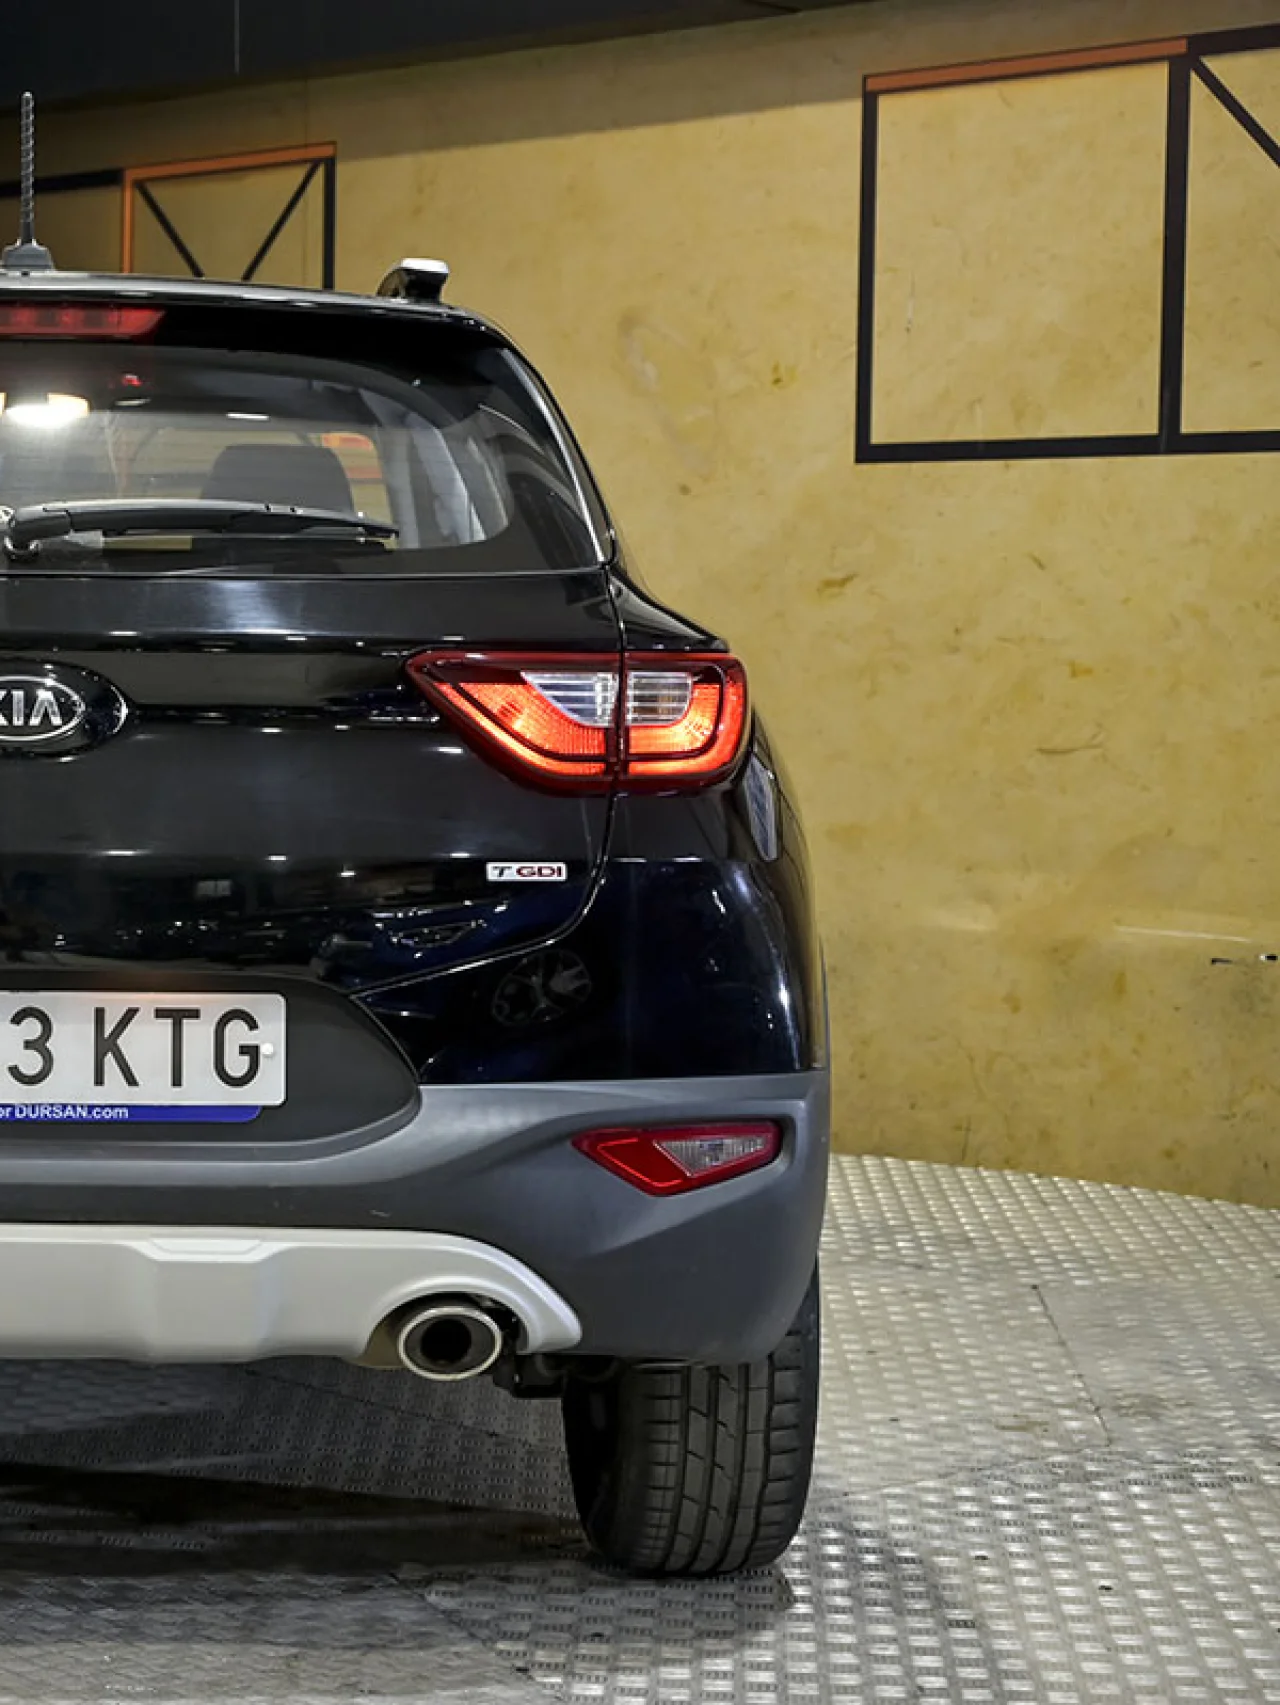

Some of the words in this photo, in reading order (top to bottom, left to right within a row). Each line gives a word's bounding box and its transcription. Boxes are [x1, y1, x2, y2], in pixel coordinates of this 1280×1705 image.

[492, 866, 512, 878] T
[516, 866, 562, 878] GDI
[93, 1006, 261, 1088] KTG
[14, 1102, 129, 1120] DURSAN.com
